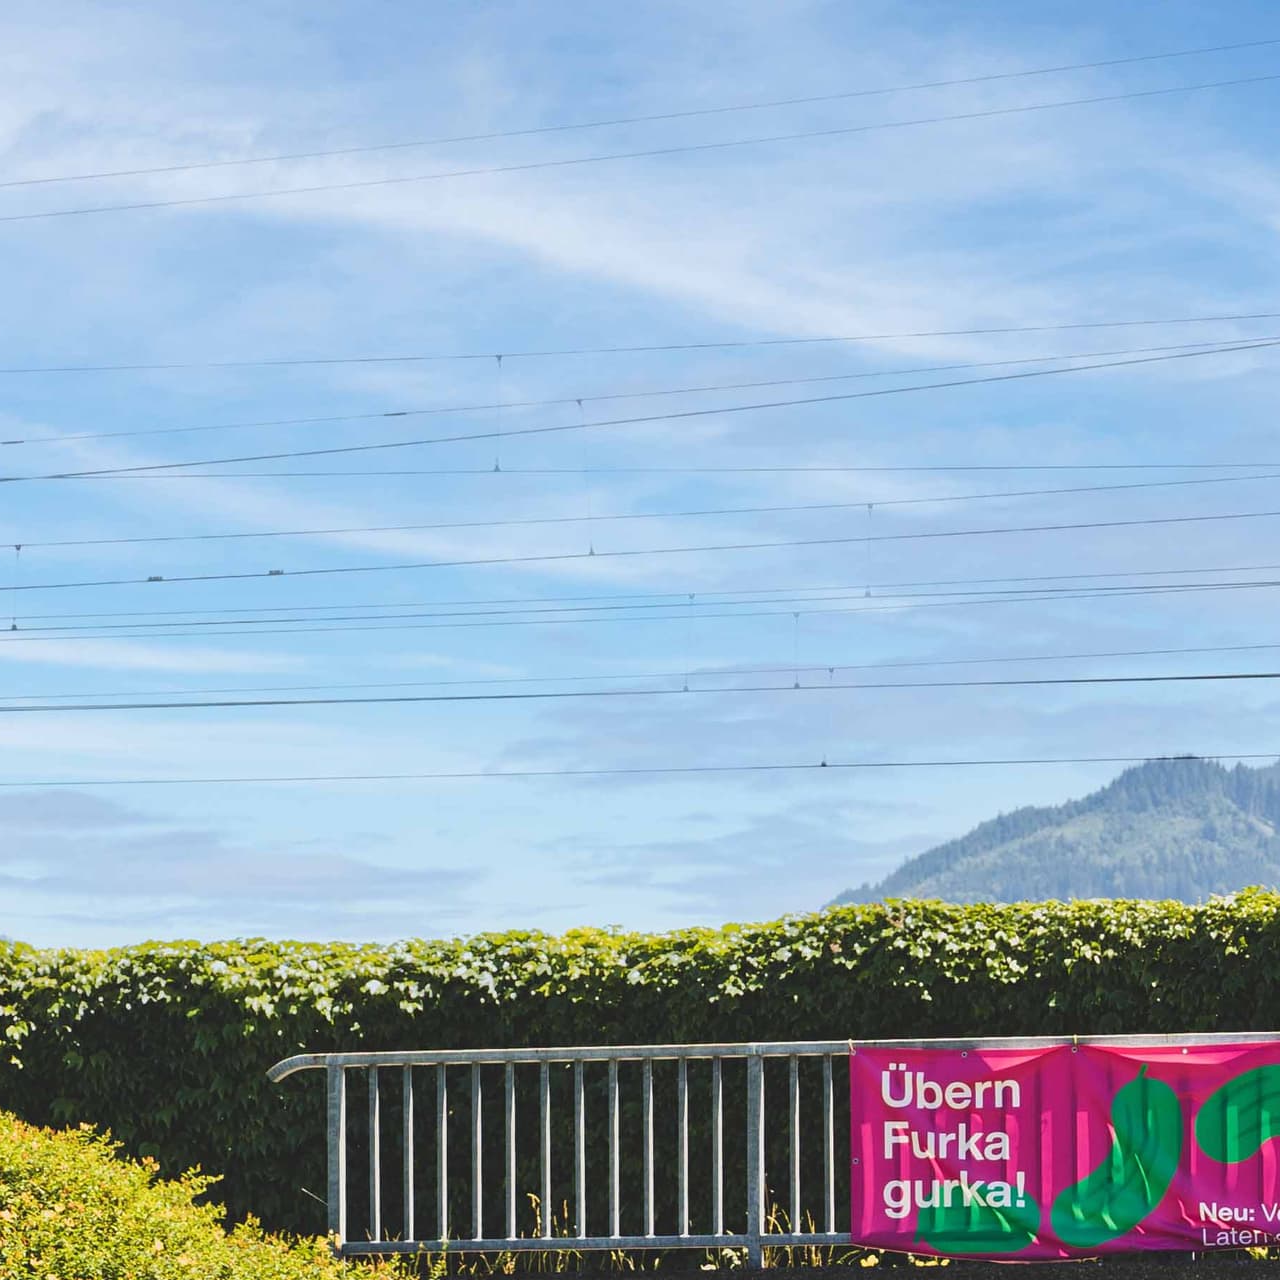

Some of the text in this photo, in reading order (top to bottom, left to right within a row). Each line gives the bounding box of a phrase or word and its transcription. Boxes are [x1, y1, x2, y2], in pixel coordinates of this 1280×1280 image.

[880, 1063, 1021, 1110] Übern
[882, 1120, 1011, 1161] Furka
[882, 1171, 1027, 1219] gurka!
[1199, 1202, 1256, 1222] Neu:
